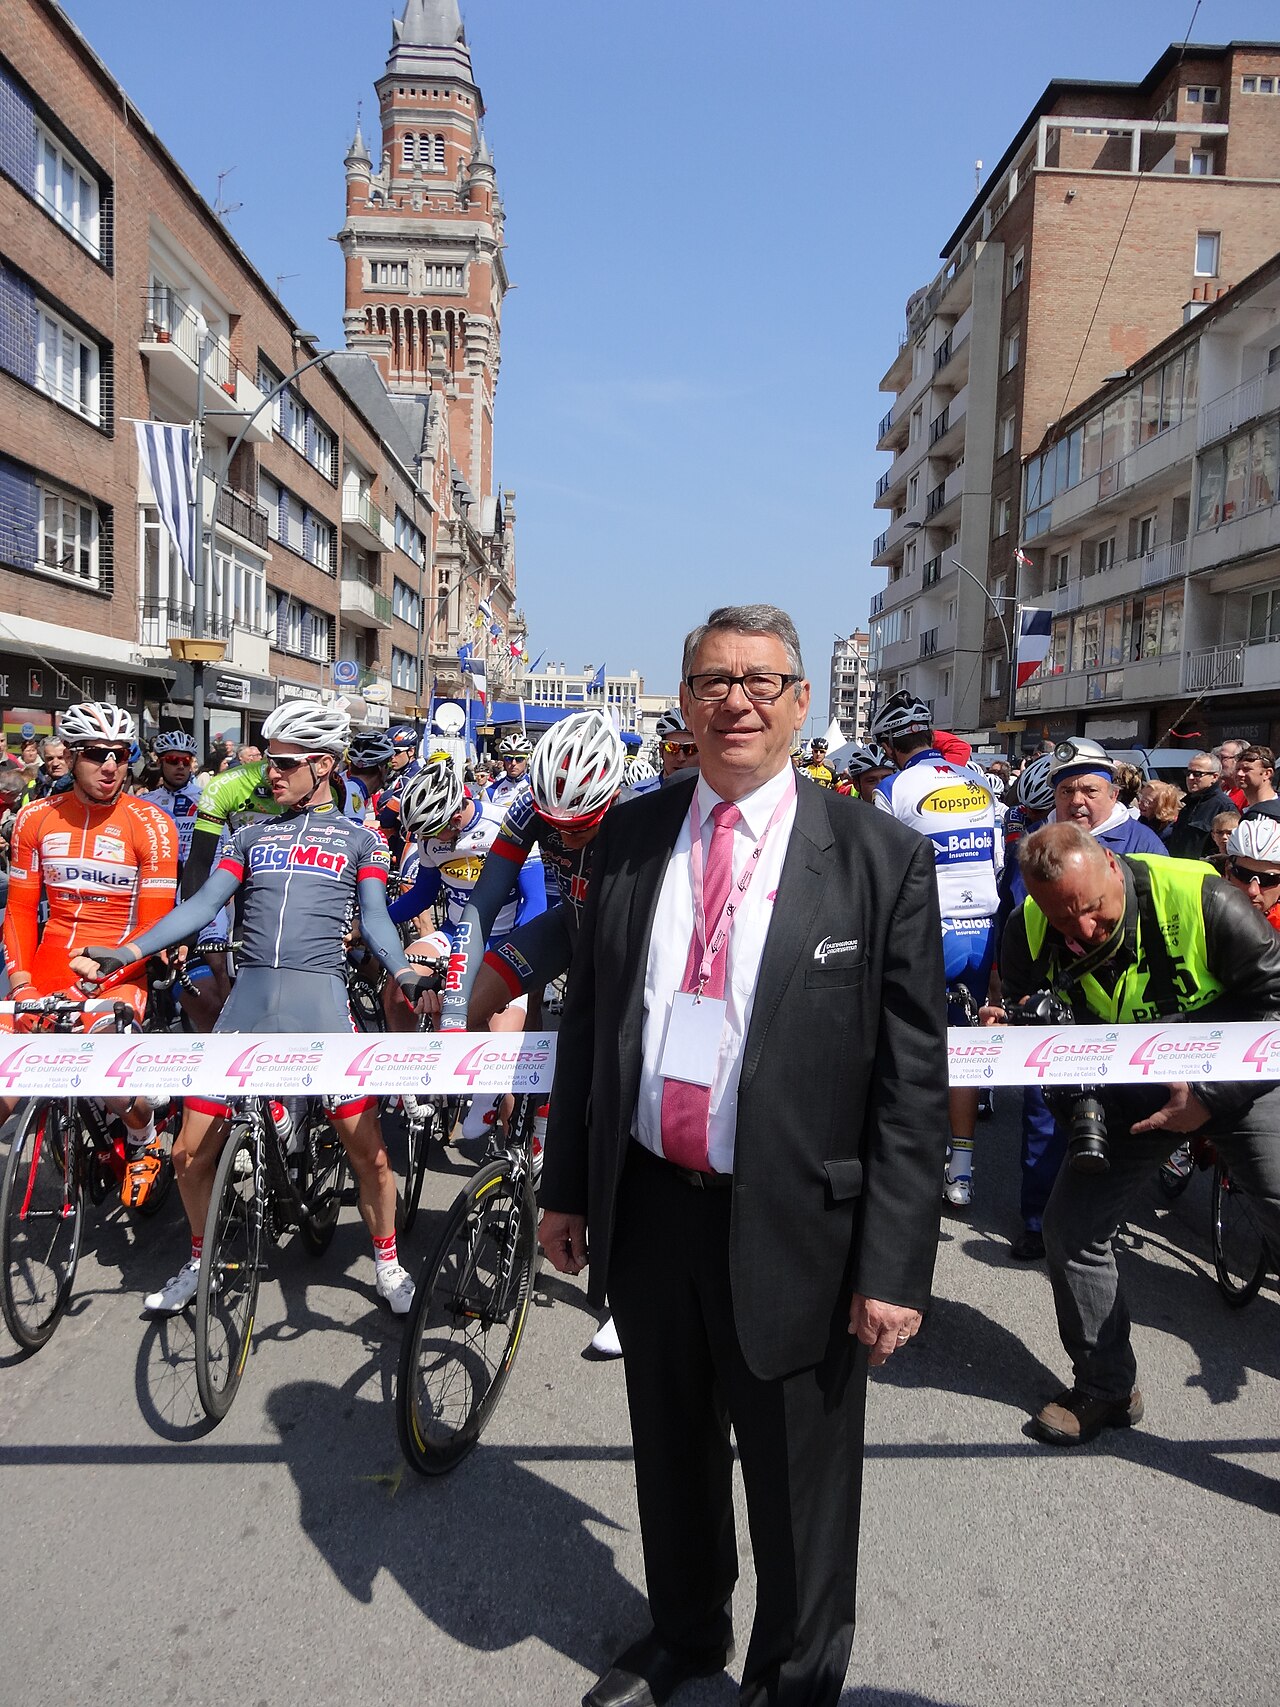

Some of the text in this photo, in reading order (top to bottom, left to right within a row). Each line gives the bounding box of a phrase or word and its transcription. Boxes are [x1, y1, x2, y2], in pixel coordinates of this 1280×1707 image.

[208, 768, 247, 795] Crelan
[930, 795, 986, 811] Topsport
[251, 843, 346, 874] BigMat
[949, 851, 979, 859] Insurance
[66, 868, 129, 885] Dalkia
